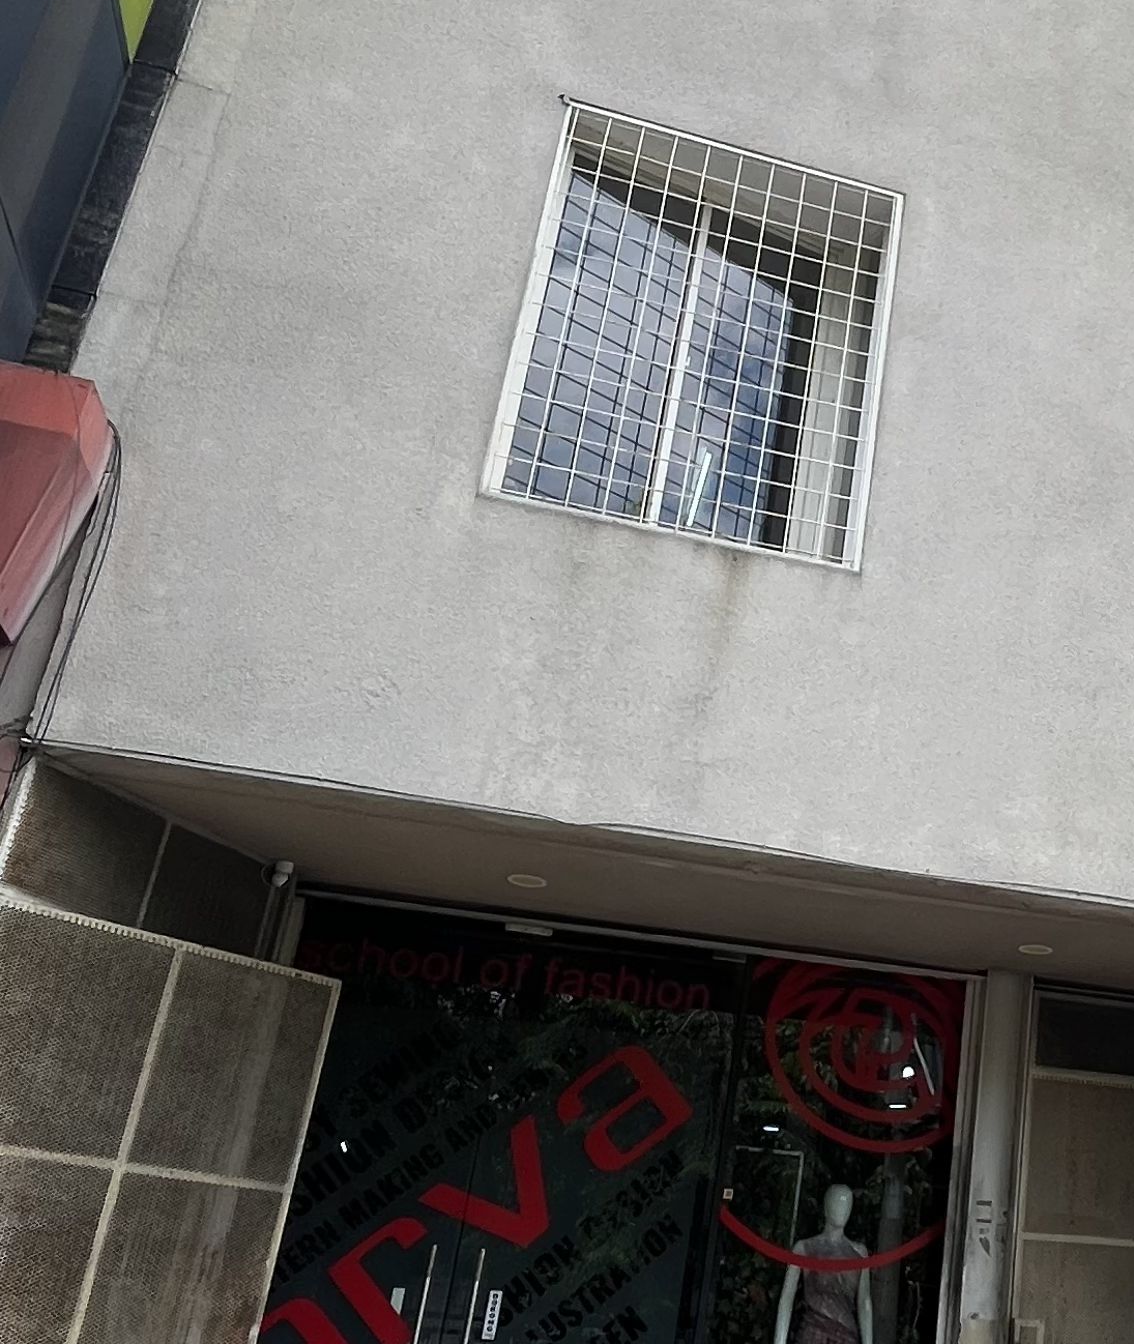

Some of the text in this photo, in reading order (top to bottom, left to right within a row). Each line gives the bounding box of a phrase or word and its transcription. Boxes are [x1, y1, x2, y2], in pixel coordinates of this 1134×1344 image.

[301, 935, 712, 1009] school of fashion
[275, 1105, 498, 1283] TERN MAKING AND
[290, 1119, 397, 1217] SHION
